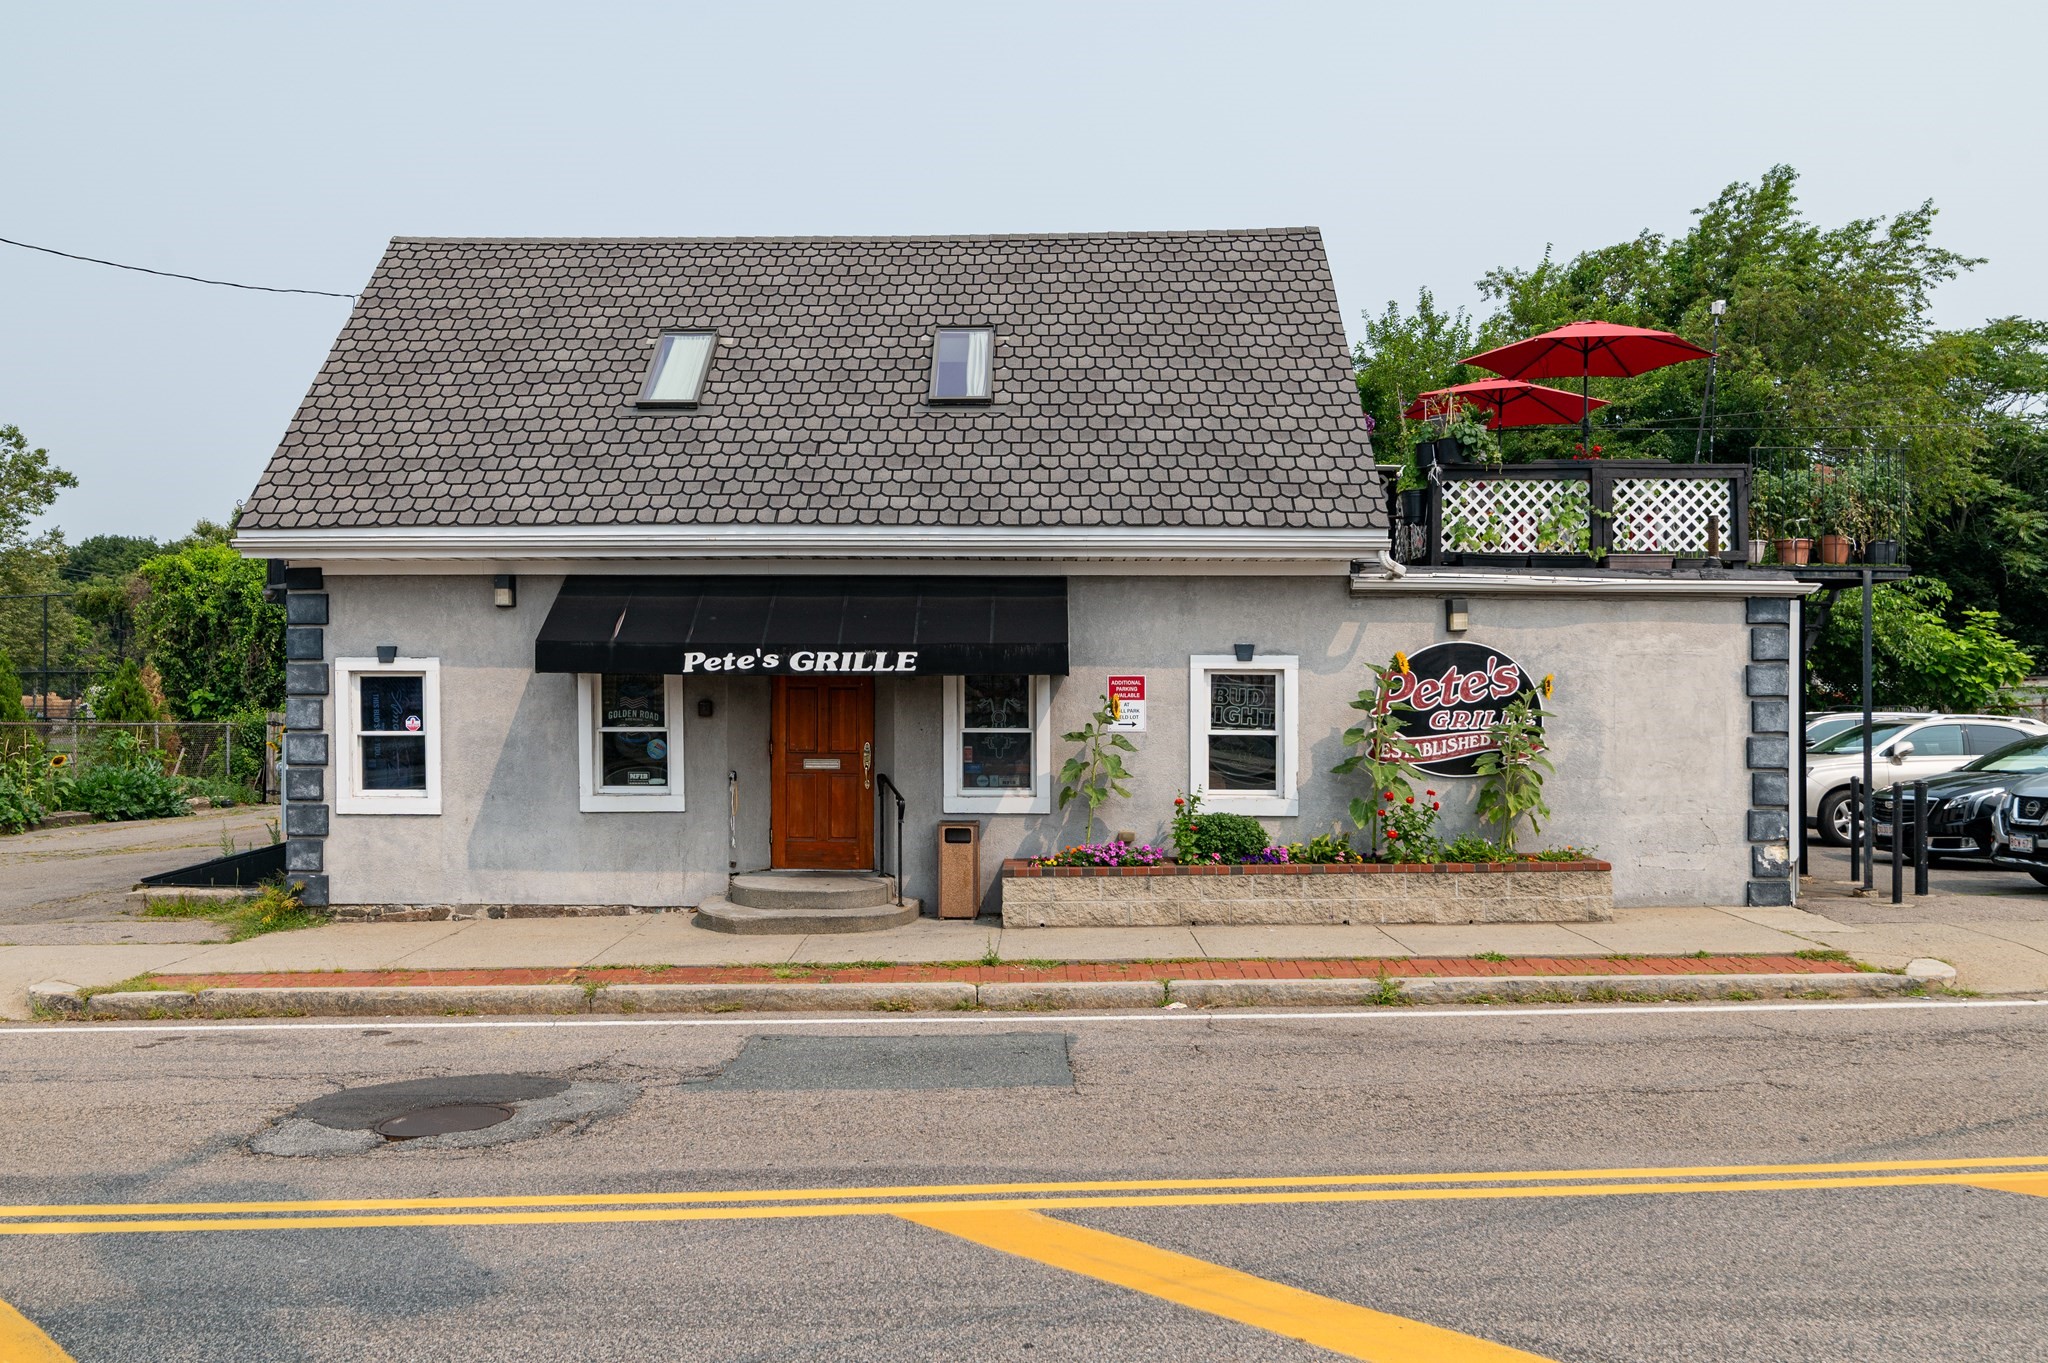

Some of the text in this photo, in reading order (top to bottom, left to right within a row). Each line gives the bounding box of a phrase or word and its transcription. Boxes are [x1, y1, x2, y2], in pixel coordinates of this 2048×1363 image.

[683, 648, 918, 673] Pete's GRILLE
[1212, 687, 1266, 706] BUD
[1369, 655, 1520, 717] Pete's
[608, 709, 659, 721] GOLDEN ROAD
[1210, 706, 1274, 726] IGHT
[1380, 734, 1491, 758] ESABLISHED
